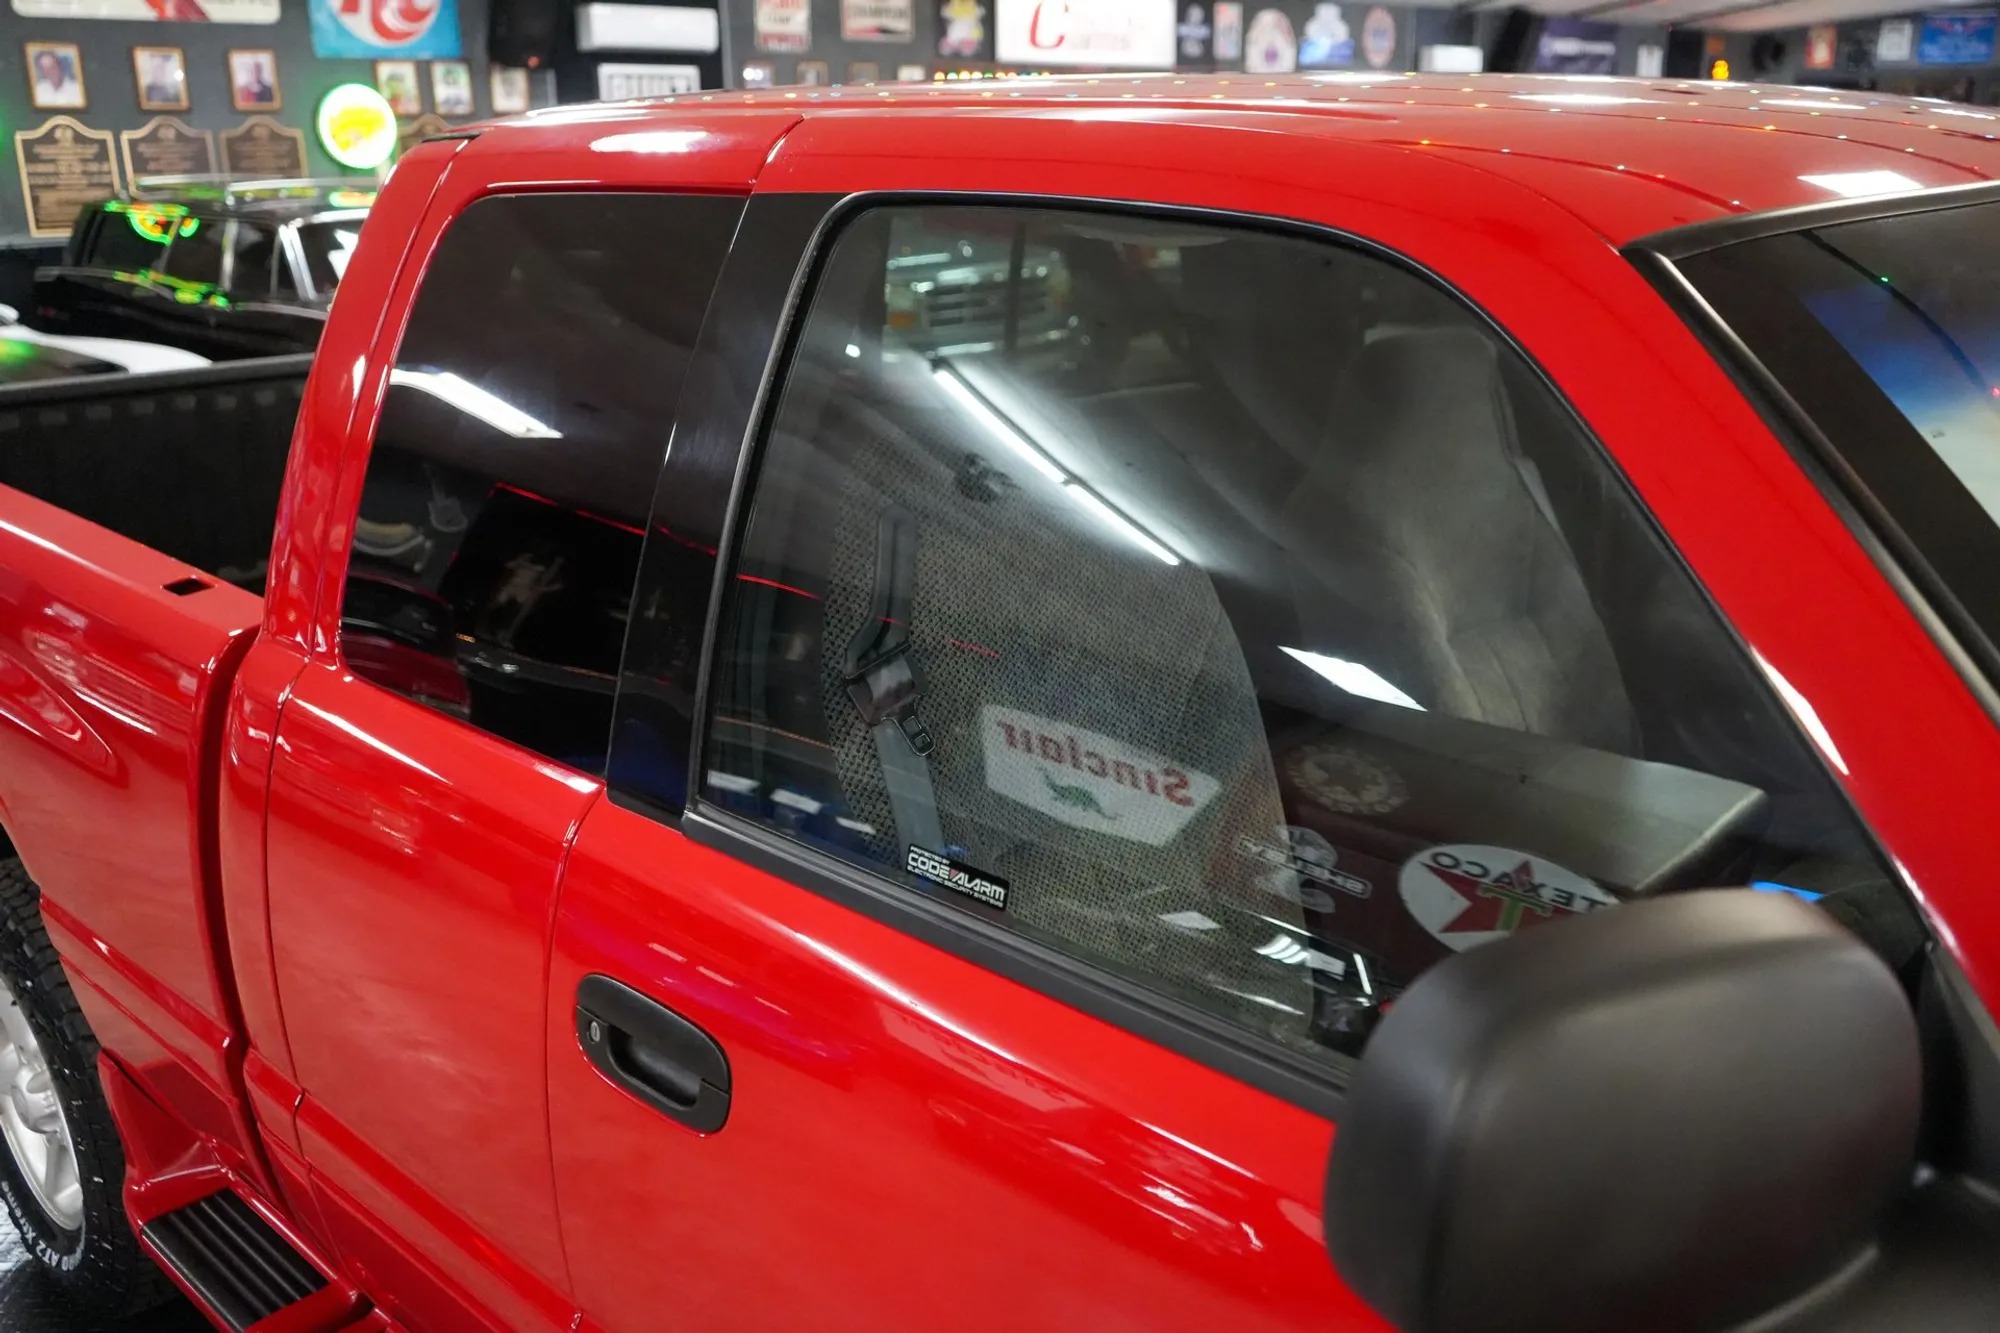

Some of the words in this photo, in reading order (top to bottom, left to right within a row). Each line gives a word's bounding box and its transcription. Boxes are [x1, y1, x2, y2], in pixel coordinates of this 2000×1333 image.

[910, 846, 942, 861] PROTECTED
[907, 865, 944, 884] ELECTRONIC
[943, 880, 974, 897] SECURITY
[973, 891, 1004, 908] SYSTEMS
[908, 852, 951, 879] CODE
[952, 872, 1006, 902] ALARM
